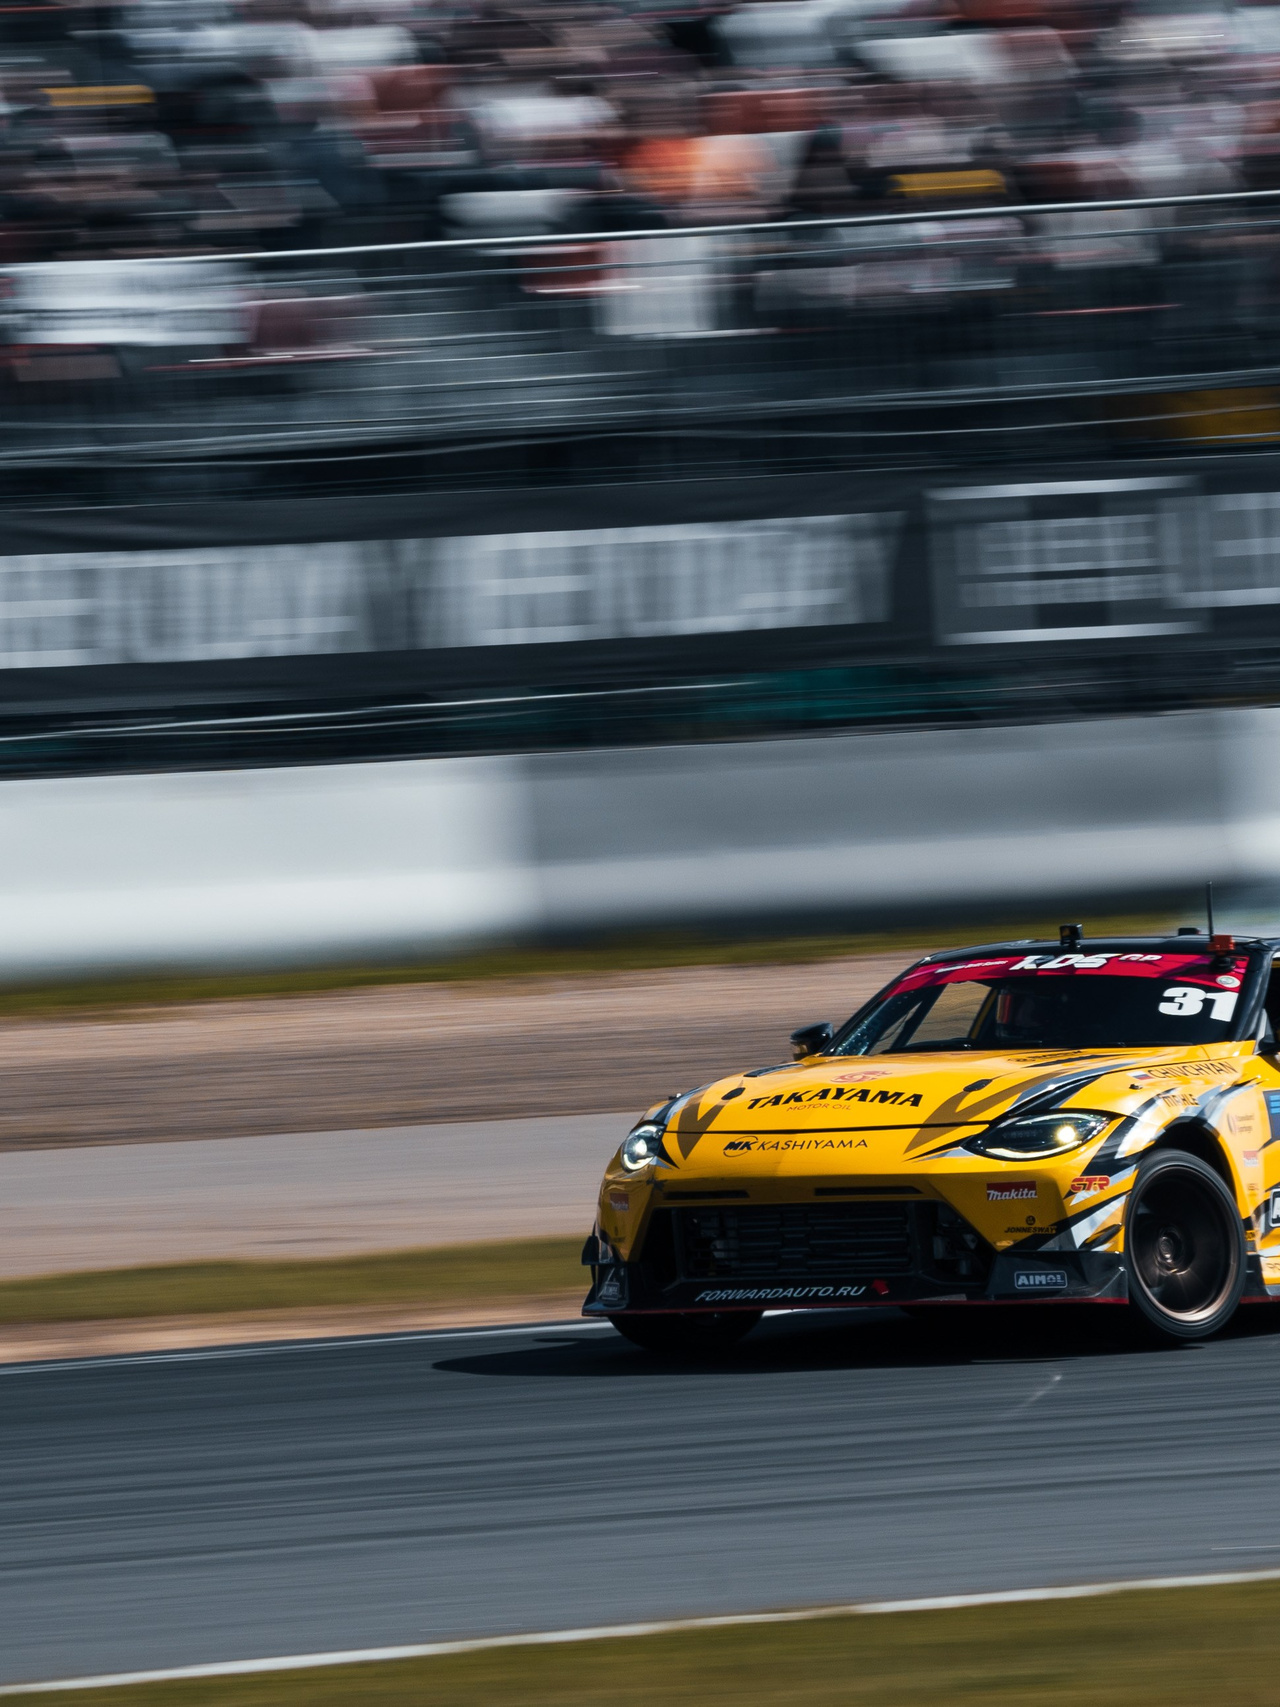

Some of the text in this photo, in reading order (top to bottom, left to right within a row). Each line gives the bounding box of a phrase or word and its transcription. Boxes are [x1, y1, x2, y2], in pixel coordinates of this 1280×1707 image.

[1008, 953, 1123, 971] RDS
[1158, 987, 1239, 1022] 31
[1147, 1061, 1239, 1079] CHIVCHYAN
[747, 1087, 923, 1110] TAKAYAMA
[786, 1103, 851, 1112] MOTOR OIL
[756, 1139, 868, 1151] KASHIYAMA
[1017, 1274, 1065, 1285] AIMOL
[695, 1285, 866, 1301] FORWARDAUTO.RU
